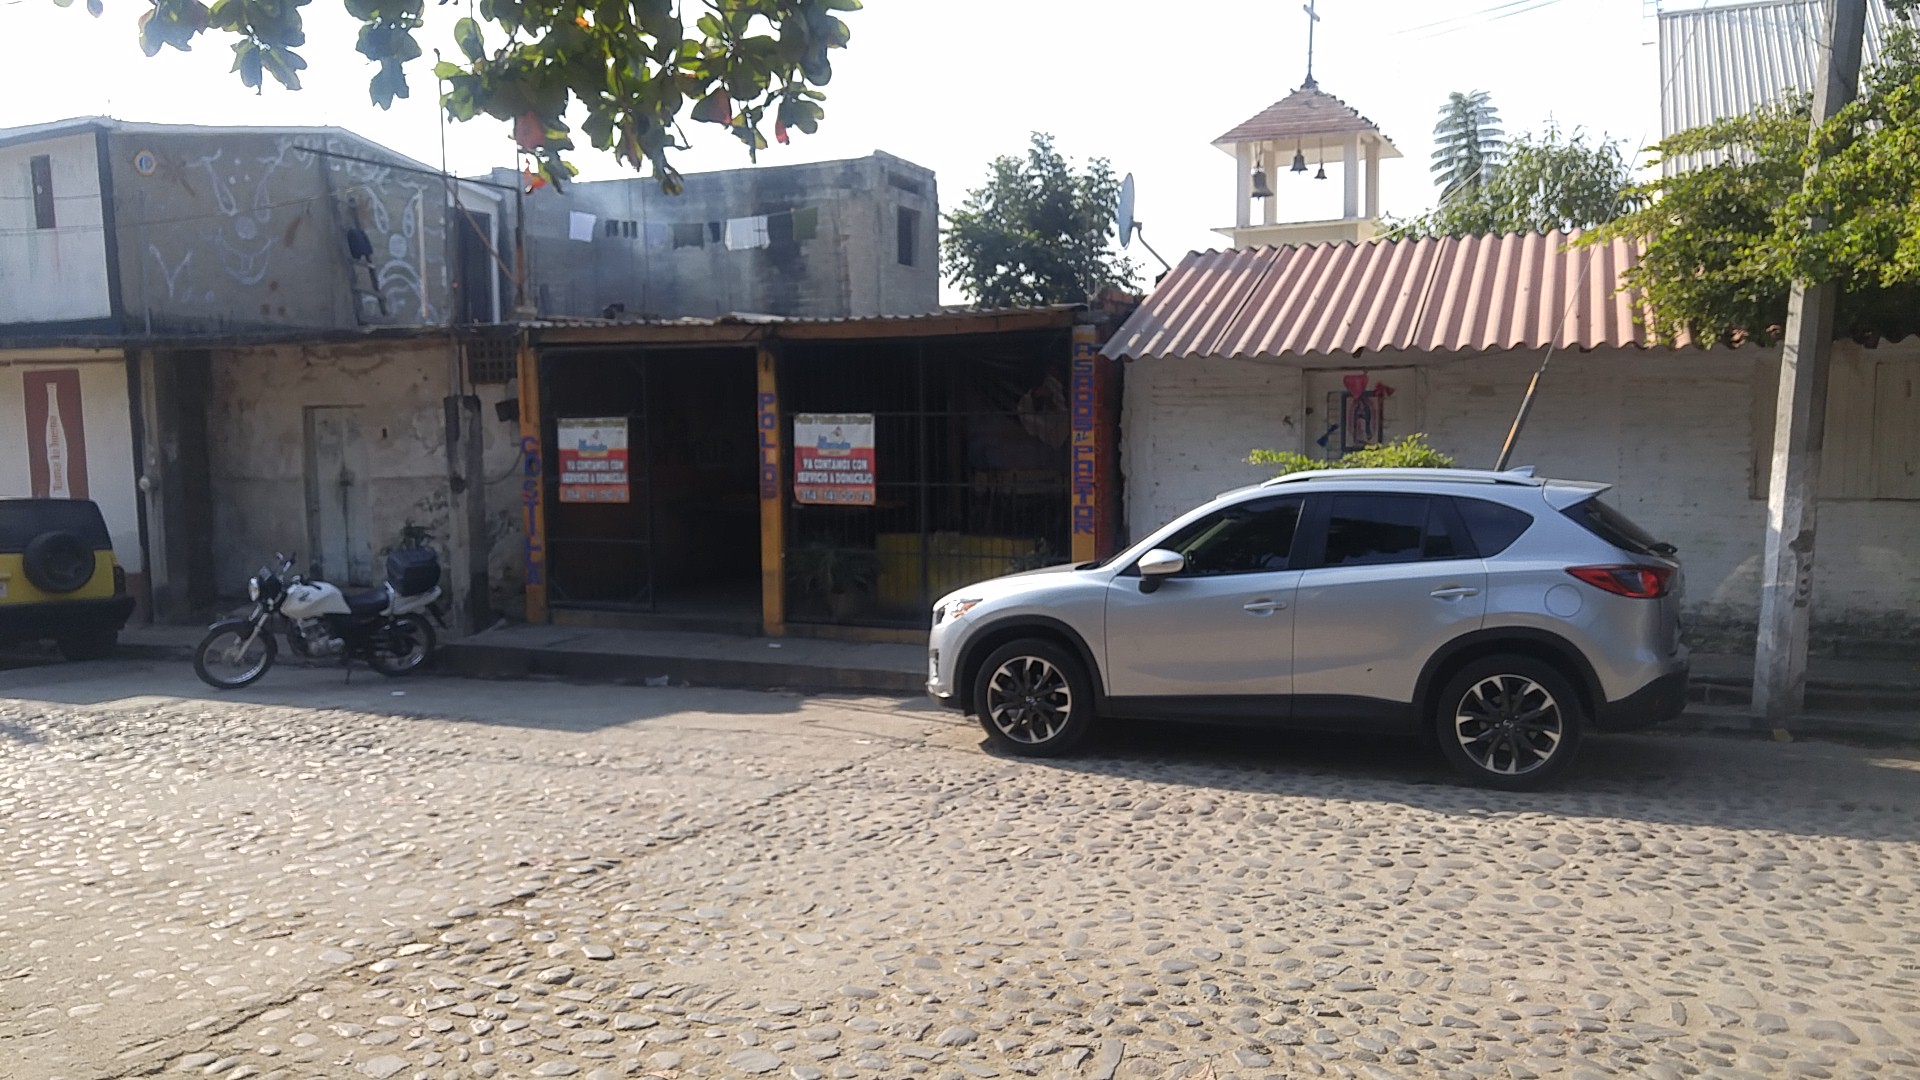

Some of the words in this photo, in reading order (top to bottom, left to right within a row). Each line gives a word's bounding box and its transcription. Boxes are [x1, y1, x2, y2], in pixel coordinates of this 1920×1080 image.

[759, 393, 776, 498] POLLOS
[803, 458, 813, 470] YA
[814, 458, 850, 471] CONTAMOS
[852, 459, 868, 471] CON
[797, 472, 828, 484] SERVICIO
[836, 472, 873, 484] DOMICILIO
[1073, 446, 1094, 535] PASTOR
